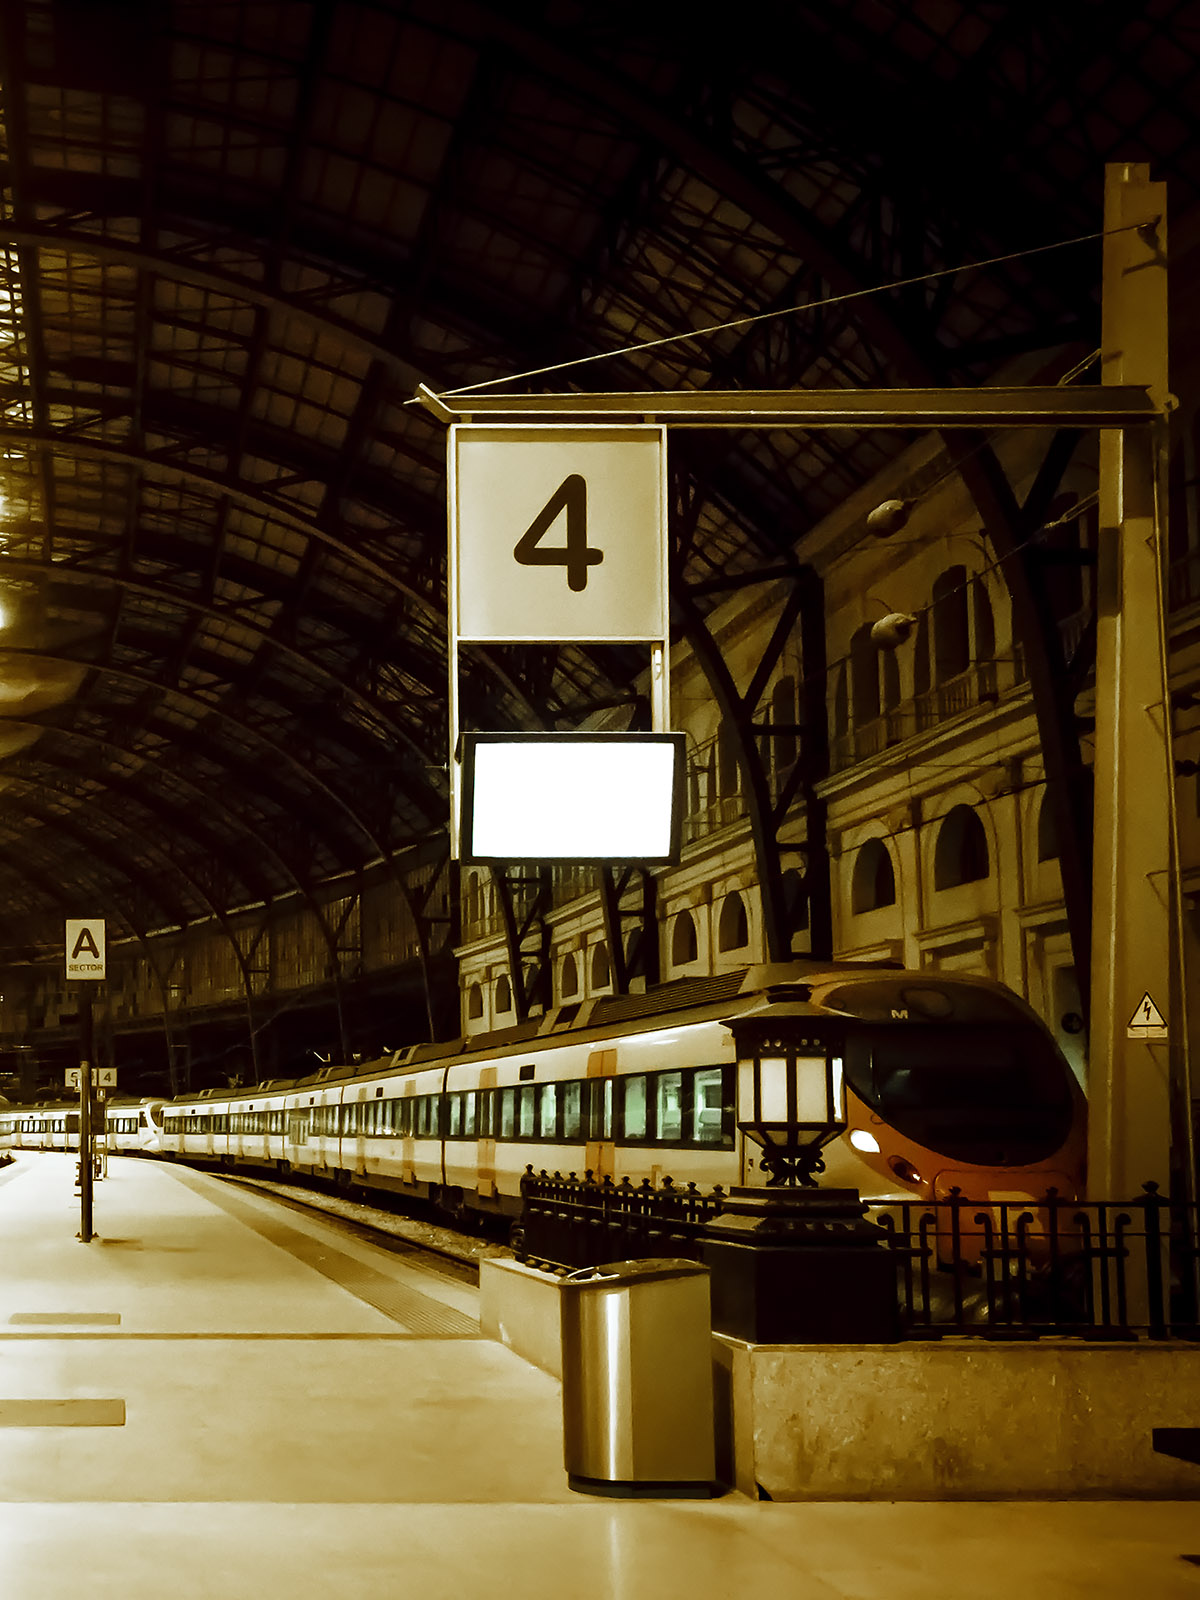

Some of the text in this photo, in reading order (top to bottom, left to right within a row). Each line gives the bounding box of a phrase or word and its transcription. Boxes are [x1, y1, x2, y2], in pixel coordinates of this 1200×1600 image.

[514, 474, 604, 592] 4
[71, 927, 100, 959] A
[68, 963, 104, 972] SECTOR
[891, 1009, 909, 1019] M
[103, 1071, 112, 1082] 4
